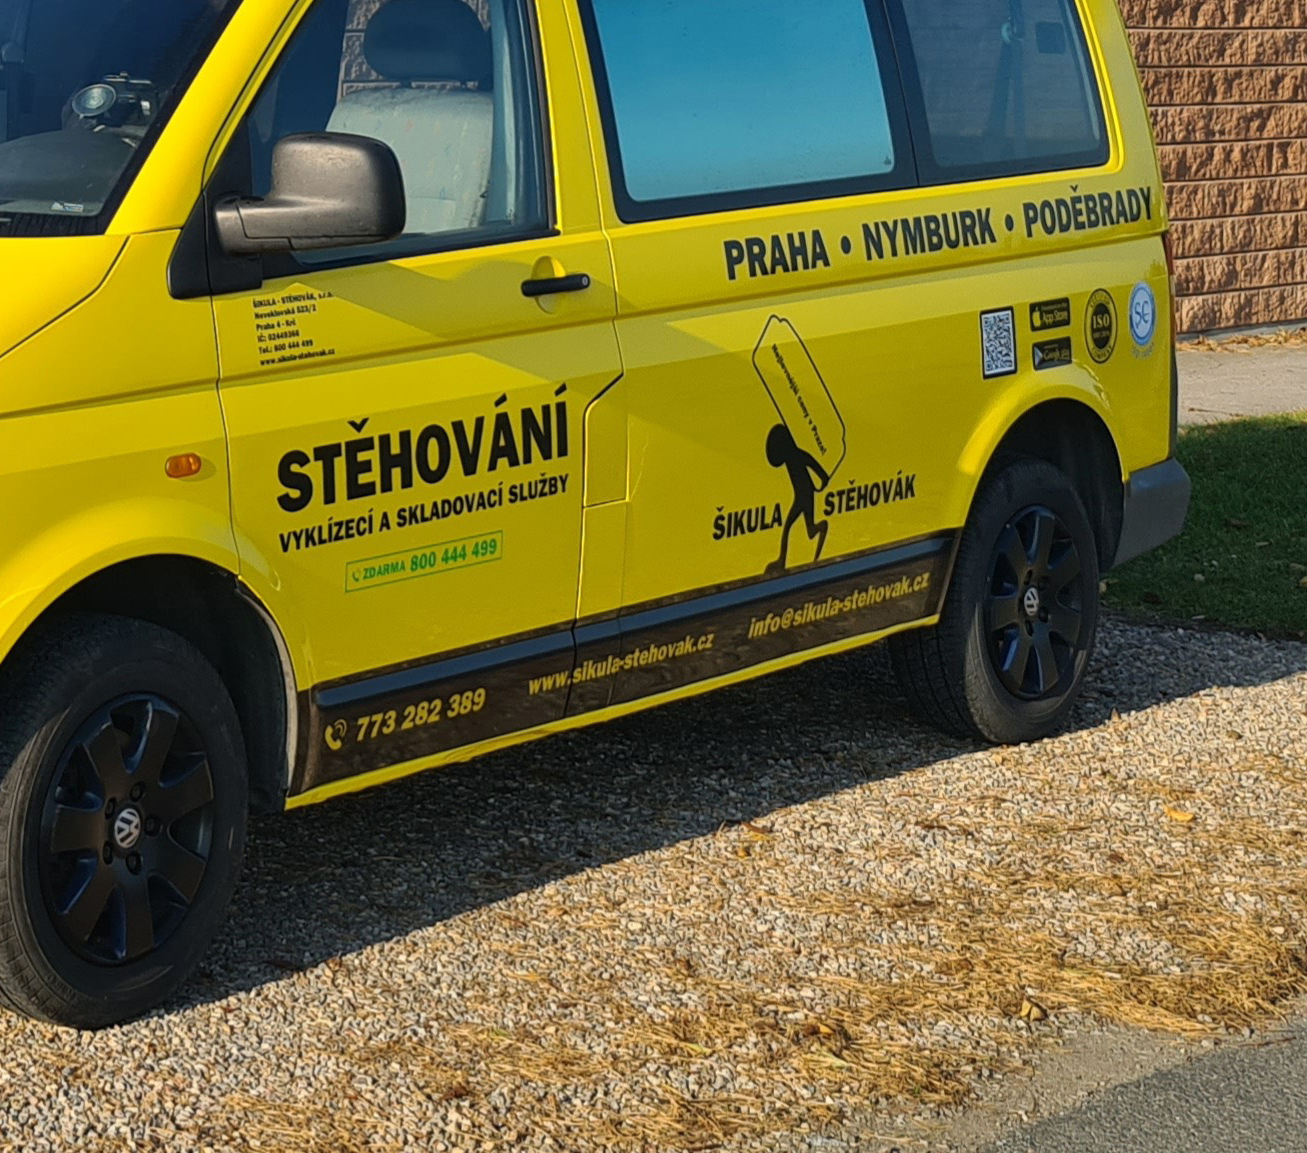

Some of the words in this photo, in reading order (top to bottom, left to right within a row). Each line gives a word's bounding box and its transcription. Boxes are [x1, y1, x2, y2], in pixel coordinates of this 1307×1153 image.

[723, 229, 831, 282] PRAHA
[862, 207, 998, 262] NYMBURK
[1023, 183, 1153, 239] PODĚBRADY
[1092, 313, 1111, 329] ISO
[276, 382, 569, 513] STĚHOVÁNÍ
[279, 508, 374, 554] VYKLÍZECÍ
[378, 511, 392, 532] A
[396, 481, 504, 528] SKLADOVACÍ
[508, 472, 570, 504] SLUŽBY
[712, 502, 784, 542] ŠIKULA
[822, 471, 918, 519] STĚHOVÁK
[362, 560, 407, 581] ZDARMA
[409, 550, 437, 573] 800
[441, 544, 469, 566] 444
[471, 537, 498, 560] 499
[747, 571, 931, 640] info@sikula-stehovak.cz
[528, 631, 715, 696] www.sikula-stehovak.cz
[356, 710, 397, 742] 773
[401, 698, 443, 731] 282
[447, 687, 486, 719] 389
